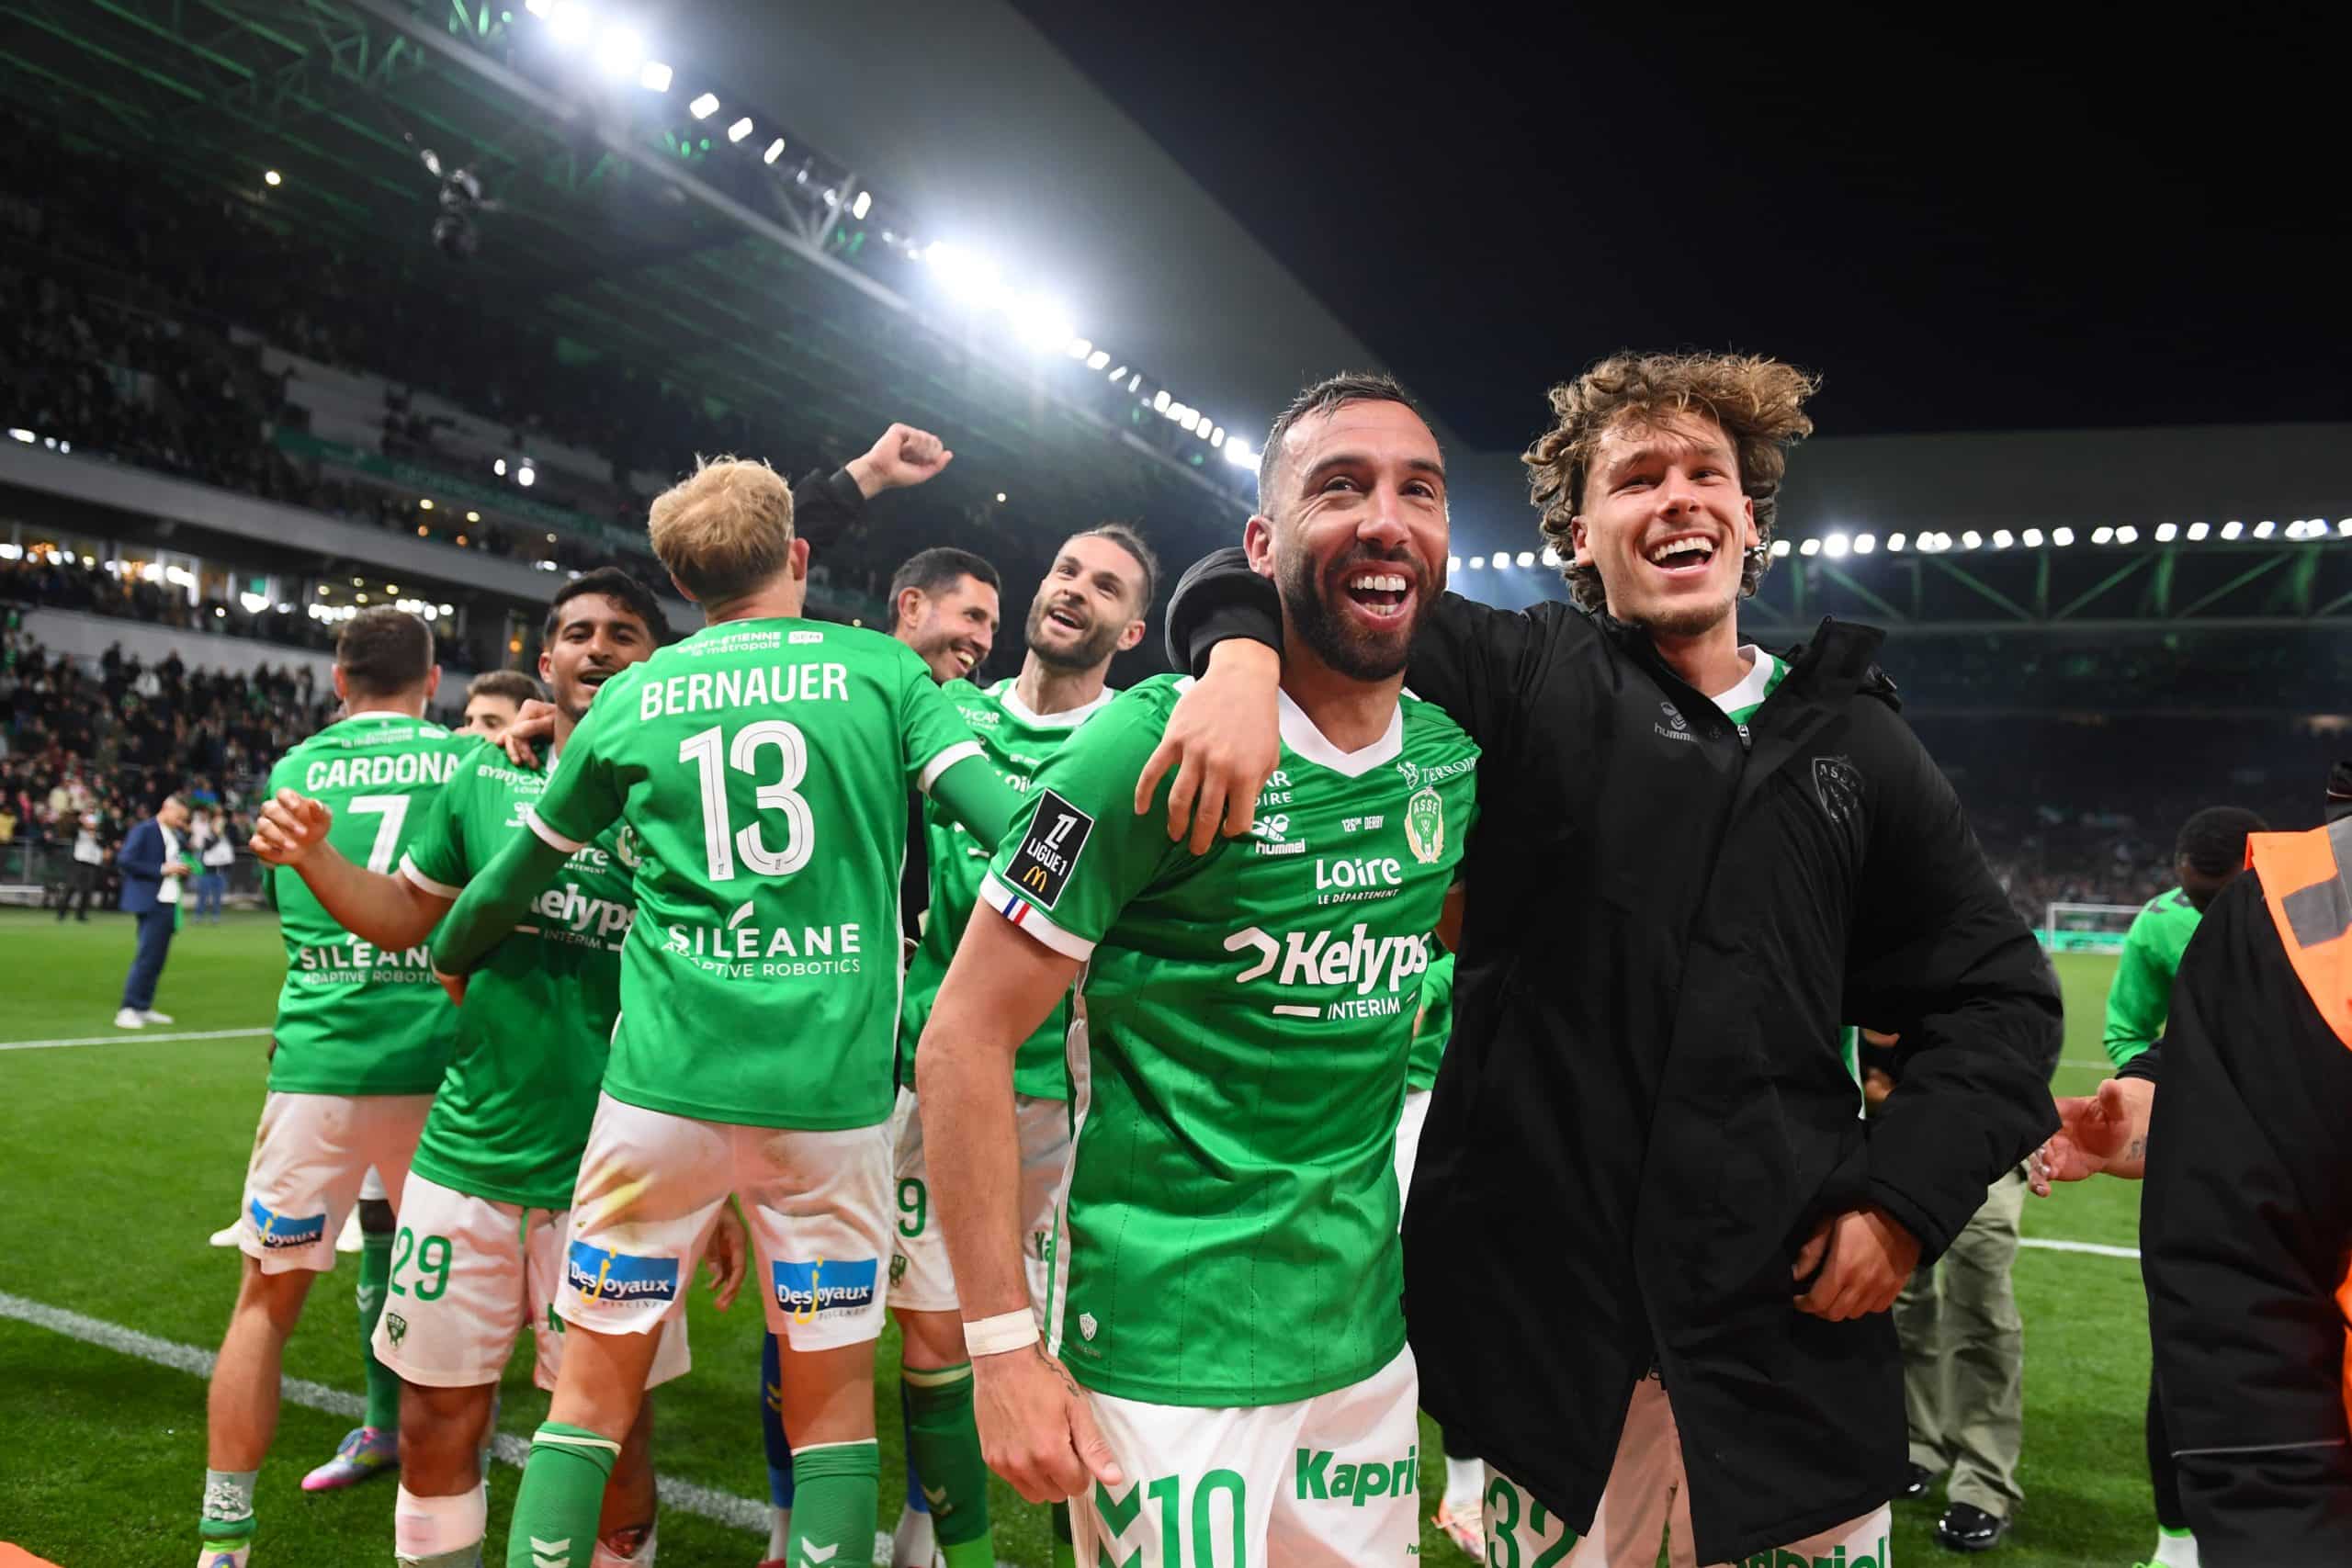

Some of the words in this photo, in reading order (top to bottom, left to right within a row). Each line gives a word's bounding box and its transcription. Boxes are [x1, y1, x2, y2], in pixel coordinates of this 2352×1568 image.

[640, 662, 849, 721] BERNAUER
[1654, 722, 1697, 742] humm
[306, 751, 460, 792] CARDONA
[678, 720, 816, 882] 13
[1414, 799, 1439, 815] ASSE
[346, 794, 412, 875] 7
[1255, 837, 1306, 855] hummel
[1316, 857, 1402, 889] Loire
[1317, 895, 1329, 905] LE
[1331, 889, 1399, 904] DÉPARTEMENT
[543, 927, 602, 949] INTERIM
[668, 900, 861, 958] SILÉANE
[301, 969, 368, 986] ADAPTIVE
[661, 941, 755, 978] ADAPTIVE
[763, 959, 861, 976] ROBOTICS
[1279, 923, 1432, 995] Kelyps
[1327, 997, 1401, 1021] INTERIM
[390, 1226, 452, 1302] 29
[1296, 1445, 1419, 1506] Kapri
[1148, 1468, 1247, 1568] 10
